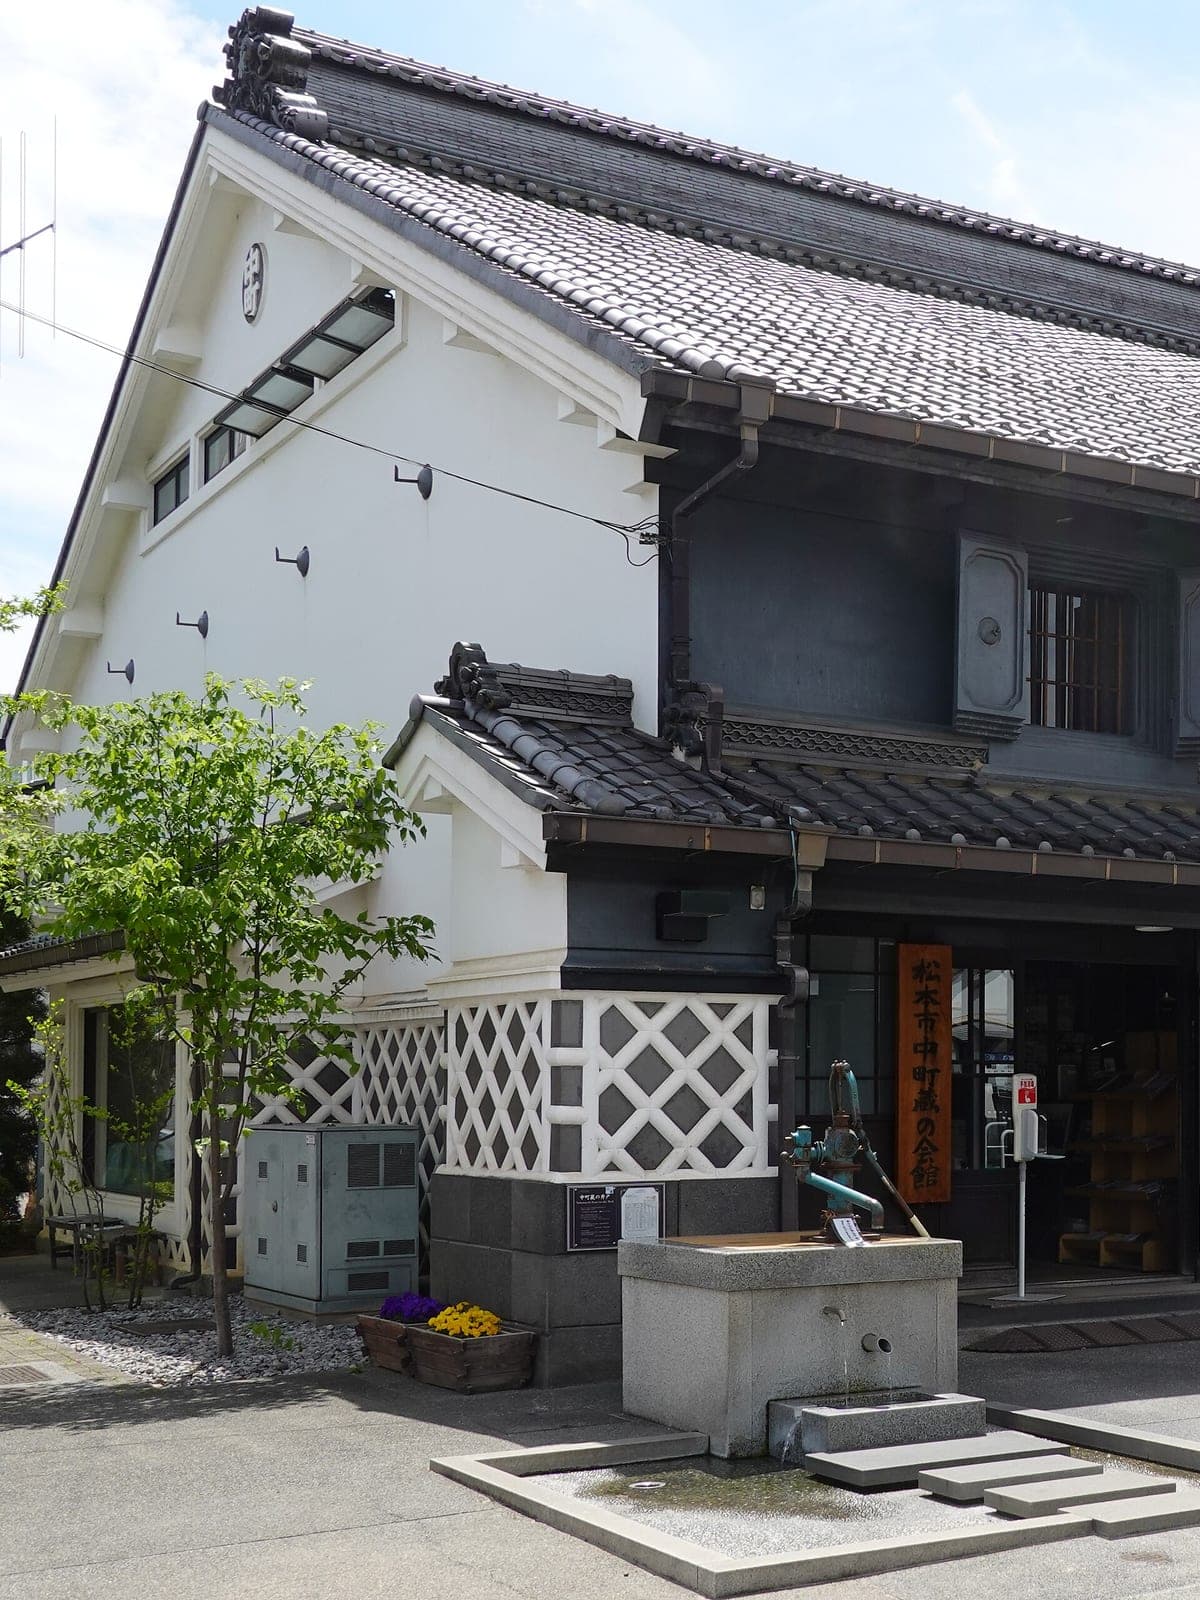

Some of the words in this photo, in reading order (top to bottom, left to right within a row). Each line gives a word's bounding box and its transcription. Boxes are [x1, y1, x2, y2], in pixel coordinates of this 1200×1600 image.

[910, 958, 942, 1190] 松本市中町蔵の会館
